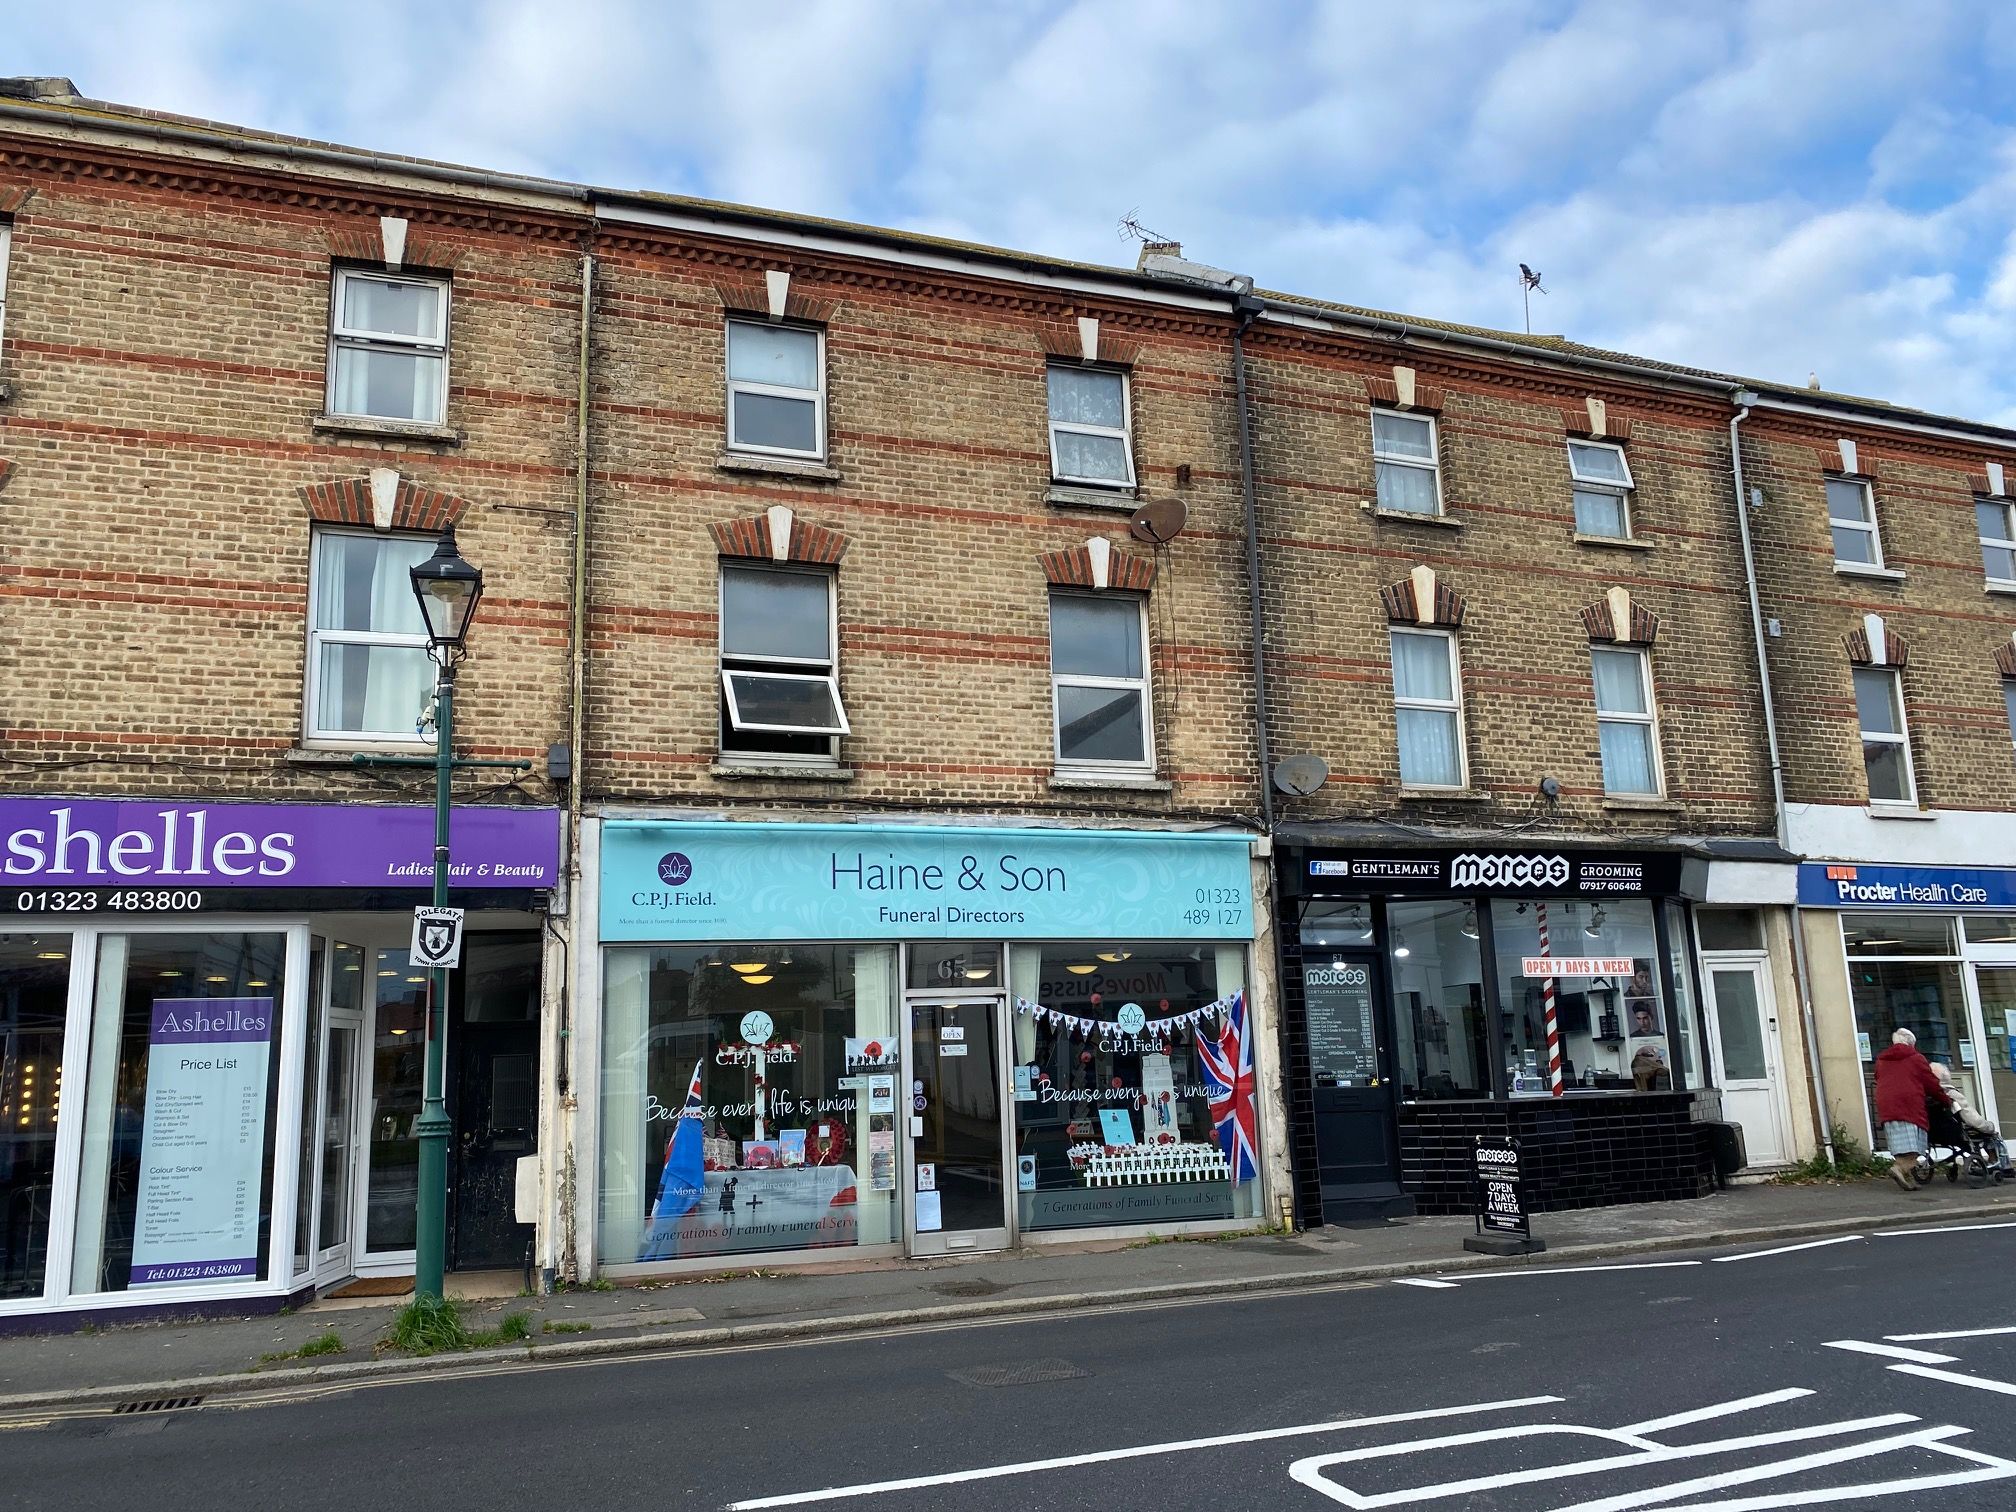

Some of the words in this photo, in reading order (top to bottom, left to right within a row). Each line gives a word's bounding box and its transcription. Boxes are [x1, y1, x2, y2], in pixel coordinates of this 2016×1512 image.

[0, 806, 297, 877] shelles
[387, 862, 434, 877] Ladies
[476, 863, 490, 877] &
[493, 863, 545, 879] Beauty
[831, 852, 944, 891] Haine
[957, 854, 986, 891] &
[1000, 854, 1067, 892] Son
[1352, 863, 1440, 875] GENTLEMAN'S
[1580, 866, 1643, 877] GROOMING
[1579, 882, 1606, 890] 07917
[1608, 882, 1642, 891] 606402
[1837, 880, 1898, 901] Procter
[1900, 882, 1948, 902] Health
[1950, 884, 1987, 903] Care
[17, 891, 98, 911] 01323
[107, 890, 202, 911] 483800
[632, 892, 673, 910] C.P.J.
[675, 891, 717, 906] Field.
[1195, 888, 1241, 904] 01323
[414, 907, 464, 922] POLEGATE
[879, 906, 940, 923] Funeral
[947, 906, 1025, 924] Directors
[1183, 909, 1210, 925] 489
[1216, 909, 1242, 926] 127
[414, 956, 430, 966] TOWN
[430, 958, 457, 967] COUNCIL
[1332, 953, 1343, 962] 67
[937, 959, 968, 979] 65
[1526, 961, 1552, 973] OPEN
[1556, 961, 1562, 973] 7
[1566, 961, 1590, 973] DAYS
[1594, 961, 1600, 972] A
[1603, 961, 1630, 973] WEEK
[158, 1010, 266, 1033] Ashelles
[1099, 1040, 1132, 1056] C.P.J.
[1133, 1040, 1167, 1052] Field.
[180, 1059, 212, 1070] Price
[216, 1057, 238, 1069] List
[764, 1050, 798, 1064] ield.
[1039, 1079, 1101, 1104] Because
[1104, 1086, 1142, 1112] every
[1184, 1082, 1226, 1110] unique
[646, 1095, 718, 1123] Because
[771, 1088, 796, 1120] life
[800, 1096, 813, 1114] is
[817, 1093, 861, 1125] uniqu
[149, 1167, 174, 1175] Colour
[176, 1165, 203, 1173] Service
[672, 1186, 697, 1196] More
[699, 1185, 719, 1194] than
[760, 1180, 794, 1191] director
[1489, 1182, 1513, 1193] OPEN
[1043, 1202, 1050, 1212] 7
[1052, 1200, 1112, 1213] Generations
[1115, 1197, 1125, 1210] of
[1127, 1195, 1162, 1210] Family
[1487, 1191, 1493, 1201] 7
[1494, 1192, 1516, 1204] DAYS
[1488, 1203, 1494, 1211] A
[1495, 1203, 1520, 1214] WEEK
[722, 1223, 735, 1239] of
[146, 1269, 166, 1280] Tel:
[166, 1266, 200, 1279] 01323
[201, 1264, 242, 1276] 483800
